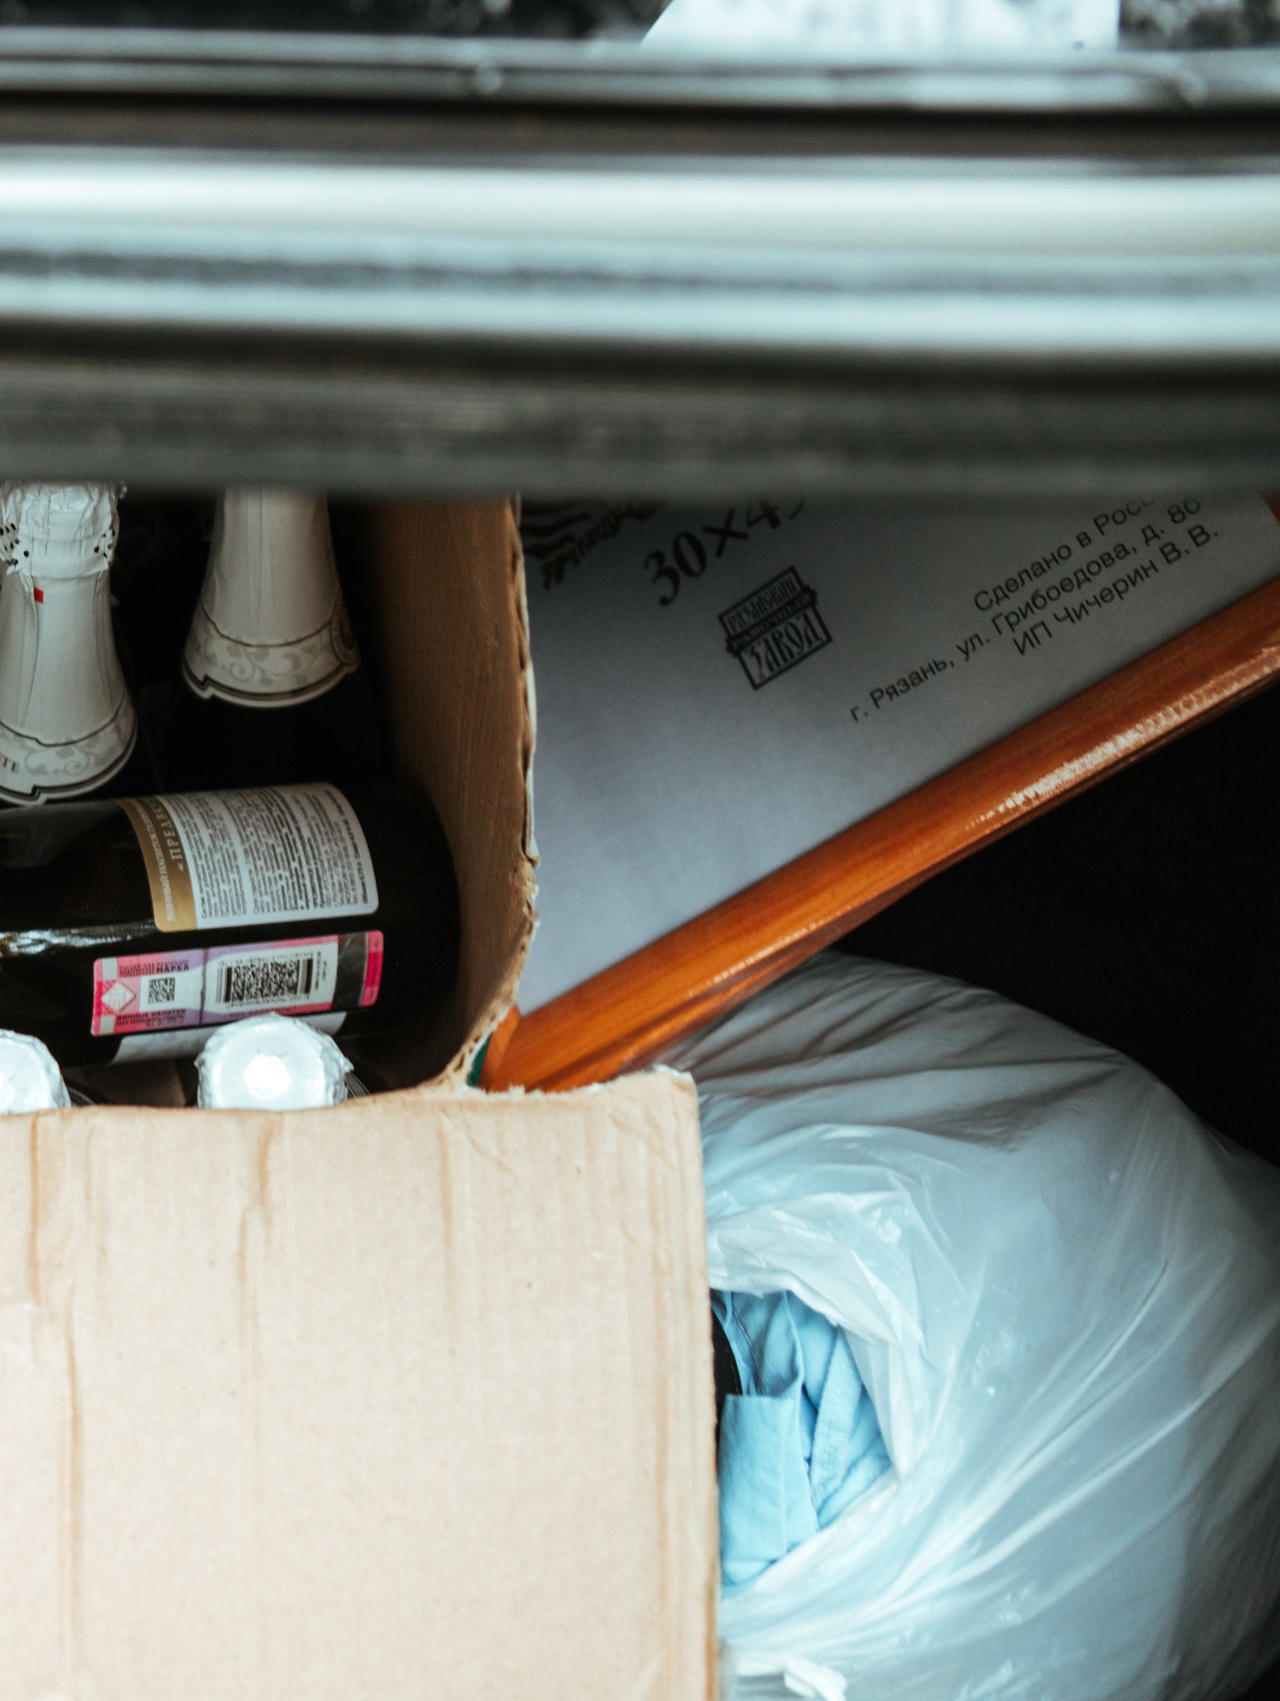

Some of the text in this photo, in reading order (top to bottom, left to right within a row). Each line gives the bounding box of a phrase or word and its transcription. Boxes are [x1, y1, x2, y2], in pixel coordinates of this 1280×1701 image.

[850, 706, 869, 723] г.
[869, 658, 955, 709] Рязань,
[956, 633, 990, 661] ул.
[991, 542, 1138, 635] Грибоедова,
[1140, 524, 1165, 547] д.
[974, 544, 1073, 612] Сделано
[1075, 531, 1092, 549] в
[1013, 524, 1219, 656] ИП Чичерин В. В.
